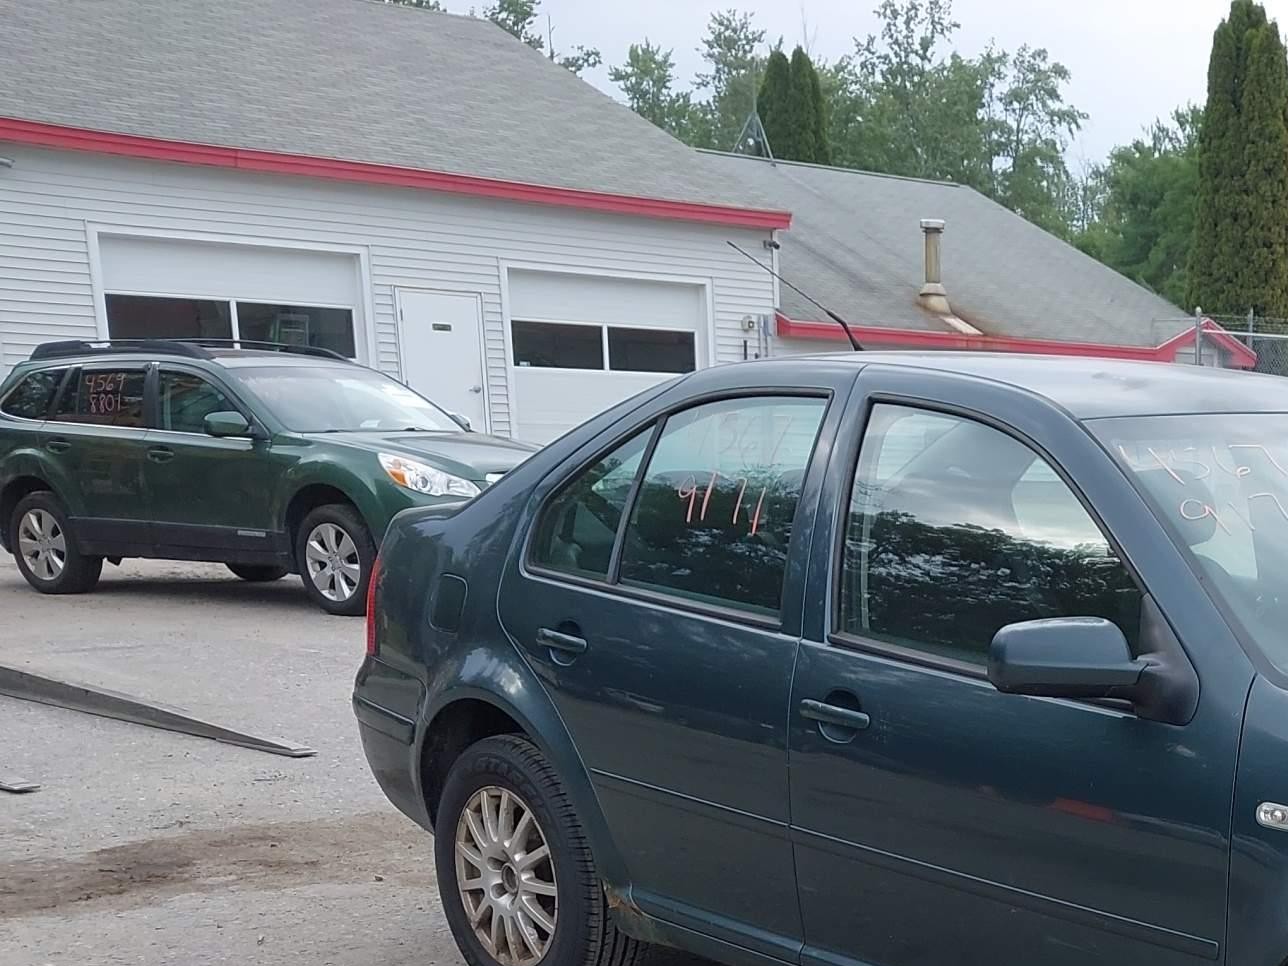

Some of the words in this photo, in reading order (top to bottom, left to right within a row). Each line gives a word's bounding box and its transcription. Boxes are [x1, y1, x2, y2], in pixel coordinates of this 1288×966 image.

[90, 393, 121, 413] 8801
[1118, 444, 1288, 486] 4567
[678, 471, 767, 537] 9171
